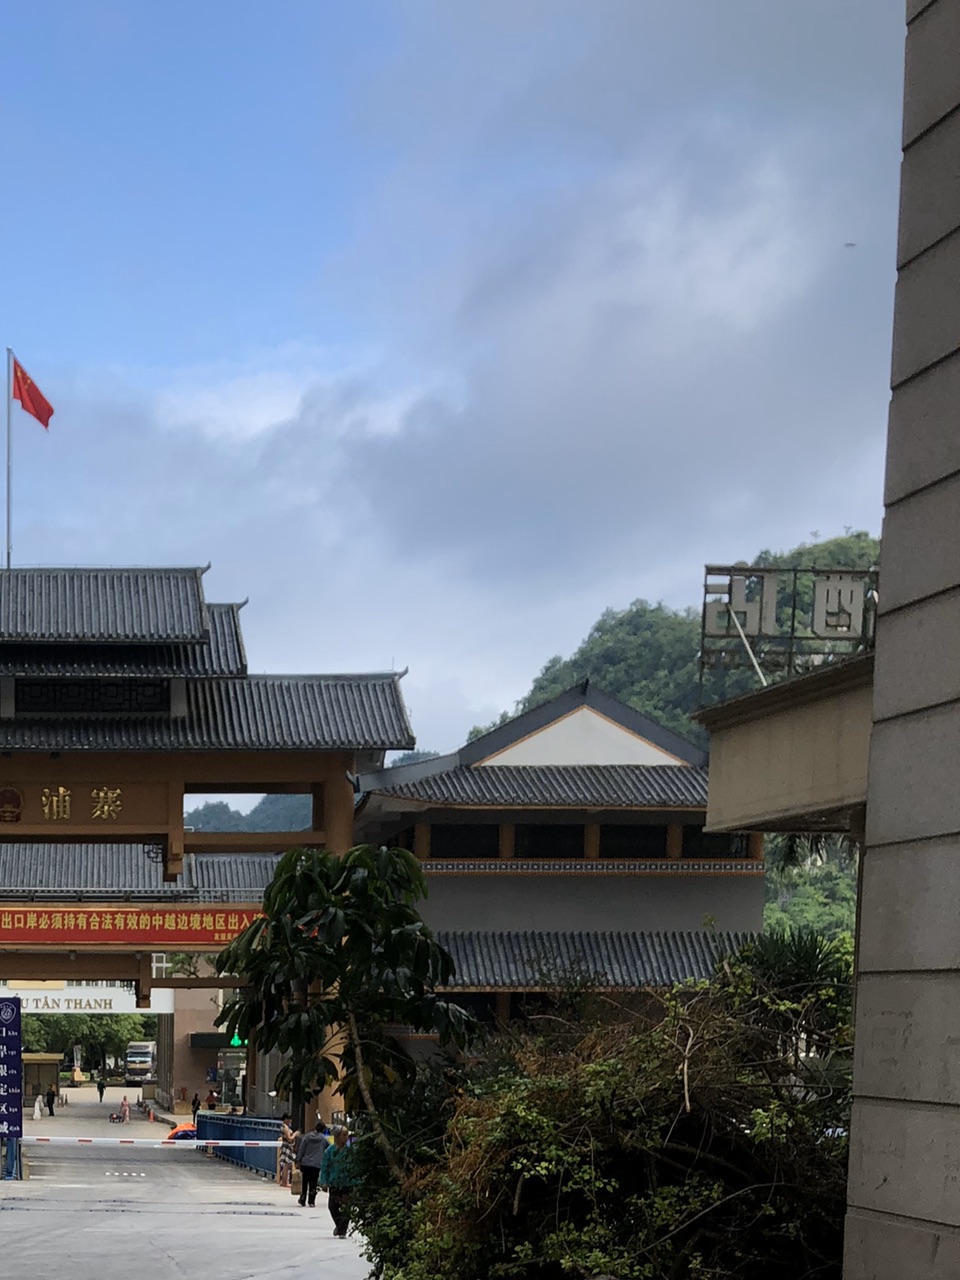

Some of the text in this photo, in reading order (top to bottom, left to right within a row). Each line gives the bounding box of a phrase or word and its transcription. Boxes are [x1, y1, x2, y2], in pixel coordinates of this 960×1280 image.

[41, 786, 123, 821] 浦寨
[33, 997, 61, 1009] TÂN
[66, 998, 113, 1010] THANH
